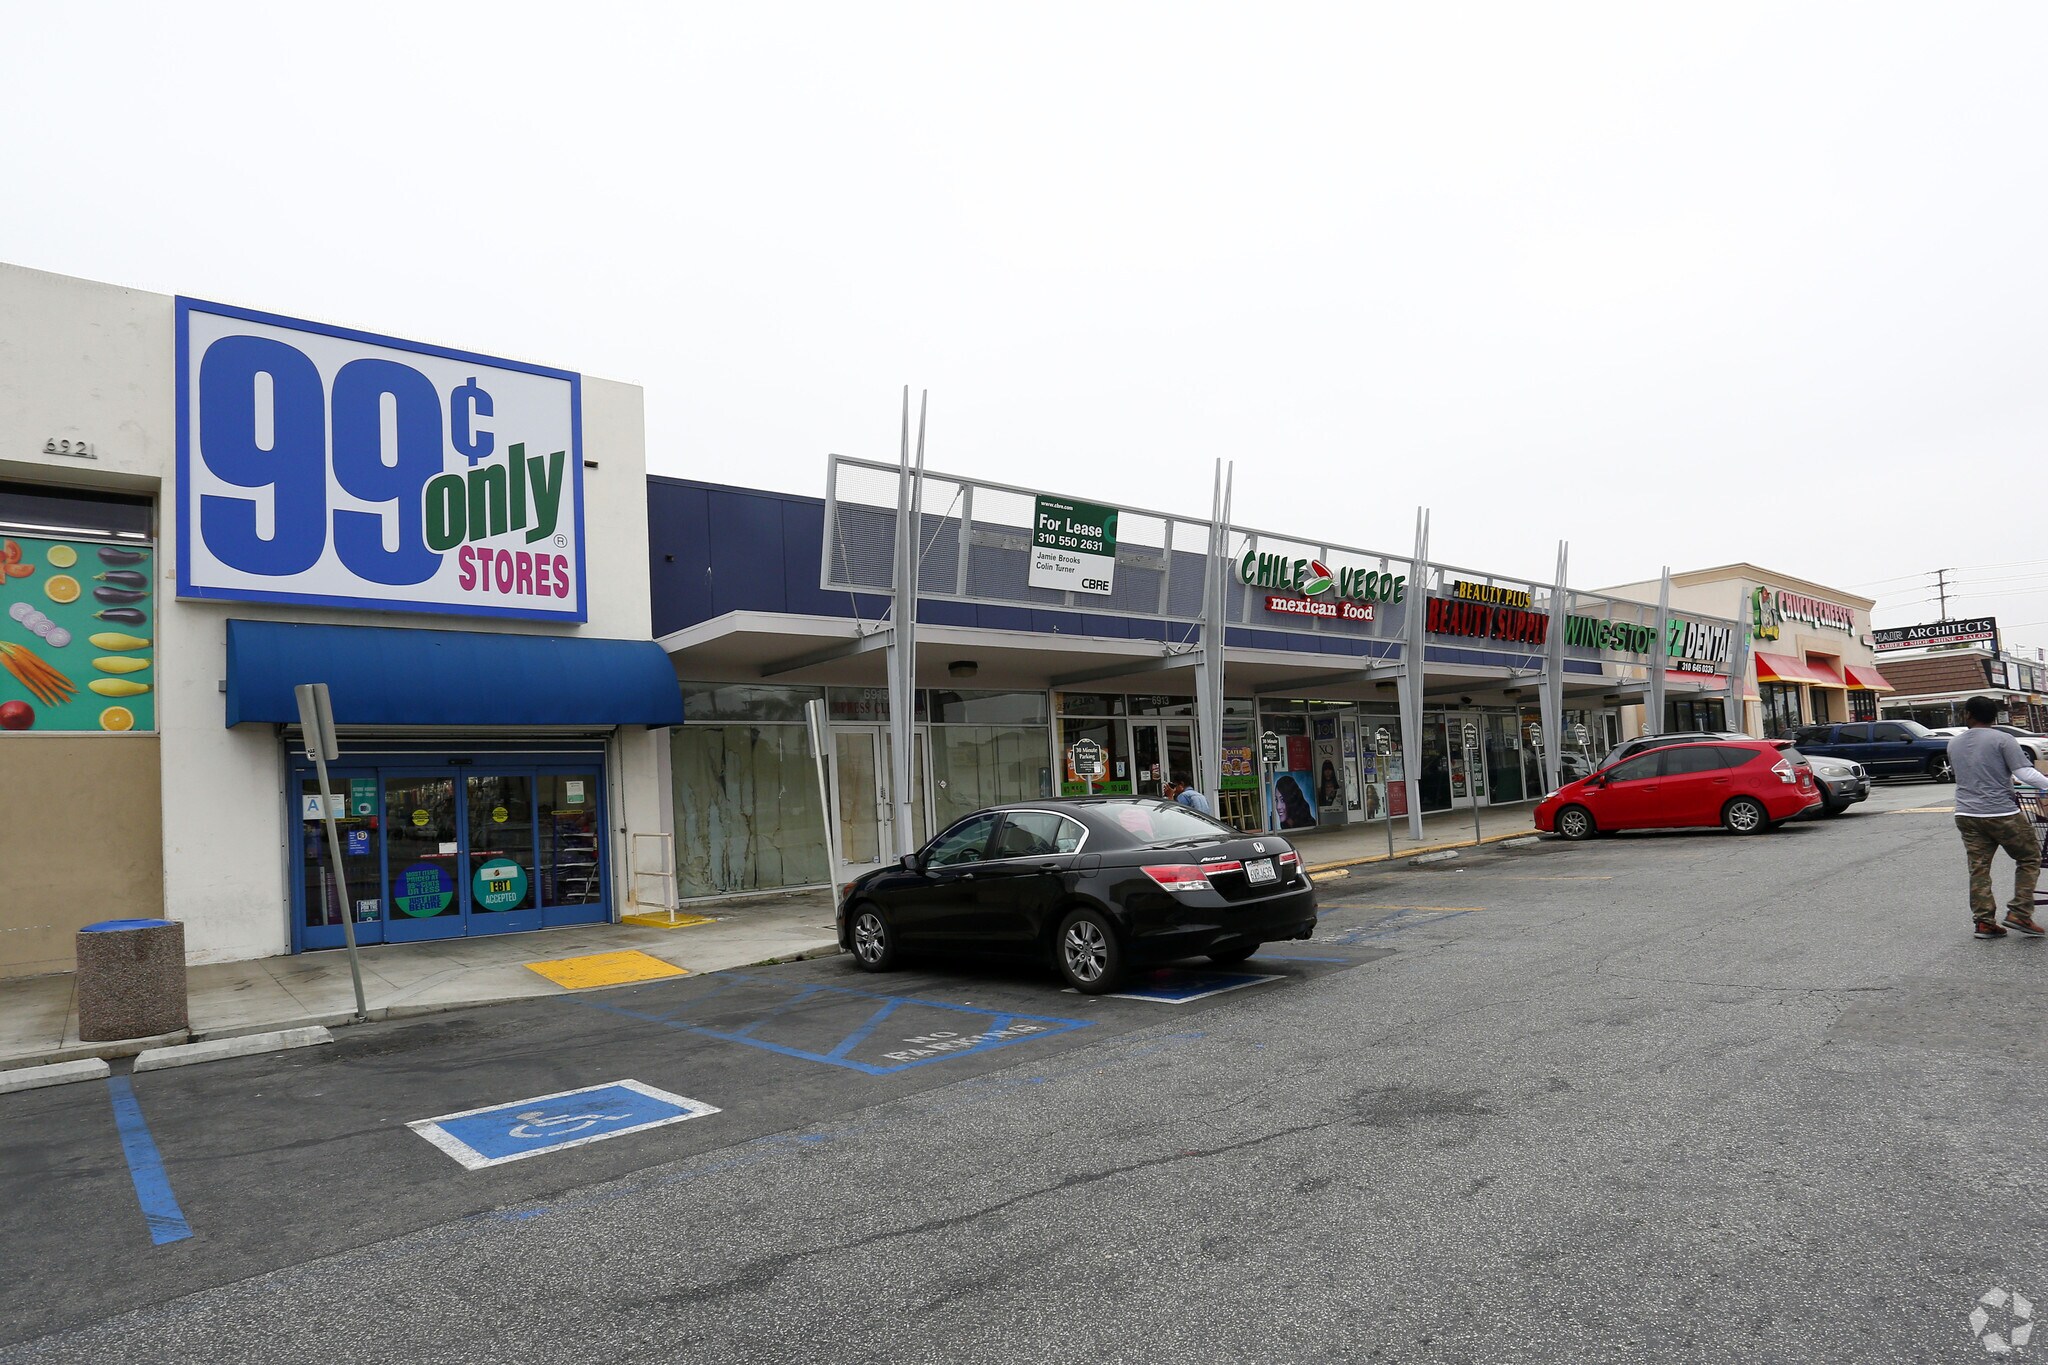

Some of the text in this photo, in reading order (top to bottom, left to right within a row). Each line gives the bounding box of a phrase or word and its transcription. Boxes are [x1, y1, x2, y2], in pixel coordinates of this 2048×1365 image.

[46, 437, 96, 457] 6921
[426, 442, 566, 552] only
[1040, 501, 1073, 511] www.cbre.com
[1039, 513, 1102, 538] For Lease
[1038, 532, 1103, 551] 310 550 2631
[1037, 552, 1081, 565] Jamie Brooks
[458, 544, 570, 600] STORES
[1036, 561, 1075, 574] Colin Turner
[1241, 549, 1406, 604] CHILE VERDE
[1081, 578, 1110, 592] CBRE
[1459, 580, 1532, 609] BEAUTY PLUS
[1271, 596, 1375, 621] mexican food
[1778, 590, 1813, 624] CHUCK
[1819, 602, 1856, 637] CHEESE'S
[1426, 596, 1550, 645] BEAUTY SUPPLY
[1872, 620, 1991, 642] HAIR ARCHITECTS
[1685, 621, 1734, 663] DENTAL
[1909, 639, 1930, 647] SHOE
[1933, 636, 1956, 645] SHINE
[1963, 632, 1990, 641] SALON
[1681, 661, 1691, 671] 310
[1692, 662, 1701, 673] 645
[863, 688, 889, 700] 6915
[1151, 695, 1170, 705] 6913
[307, 799, 319, 811] A
[1200, 854, 1227, 863] Accord
[421, 886, 440, 894] LESS
[493, 881, 508, 892] EBT
[486, 892, 517, 904] ACCEPTED
[409, 901, 442, 912] BEFORE
[879, 1024, 1047, 1063] PARKING
[902, 1031, 958, 1044] NO
